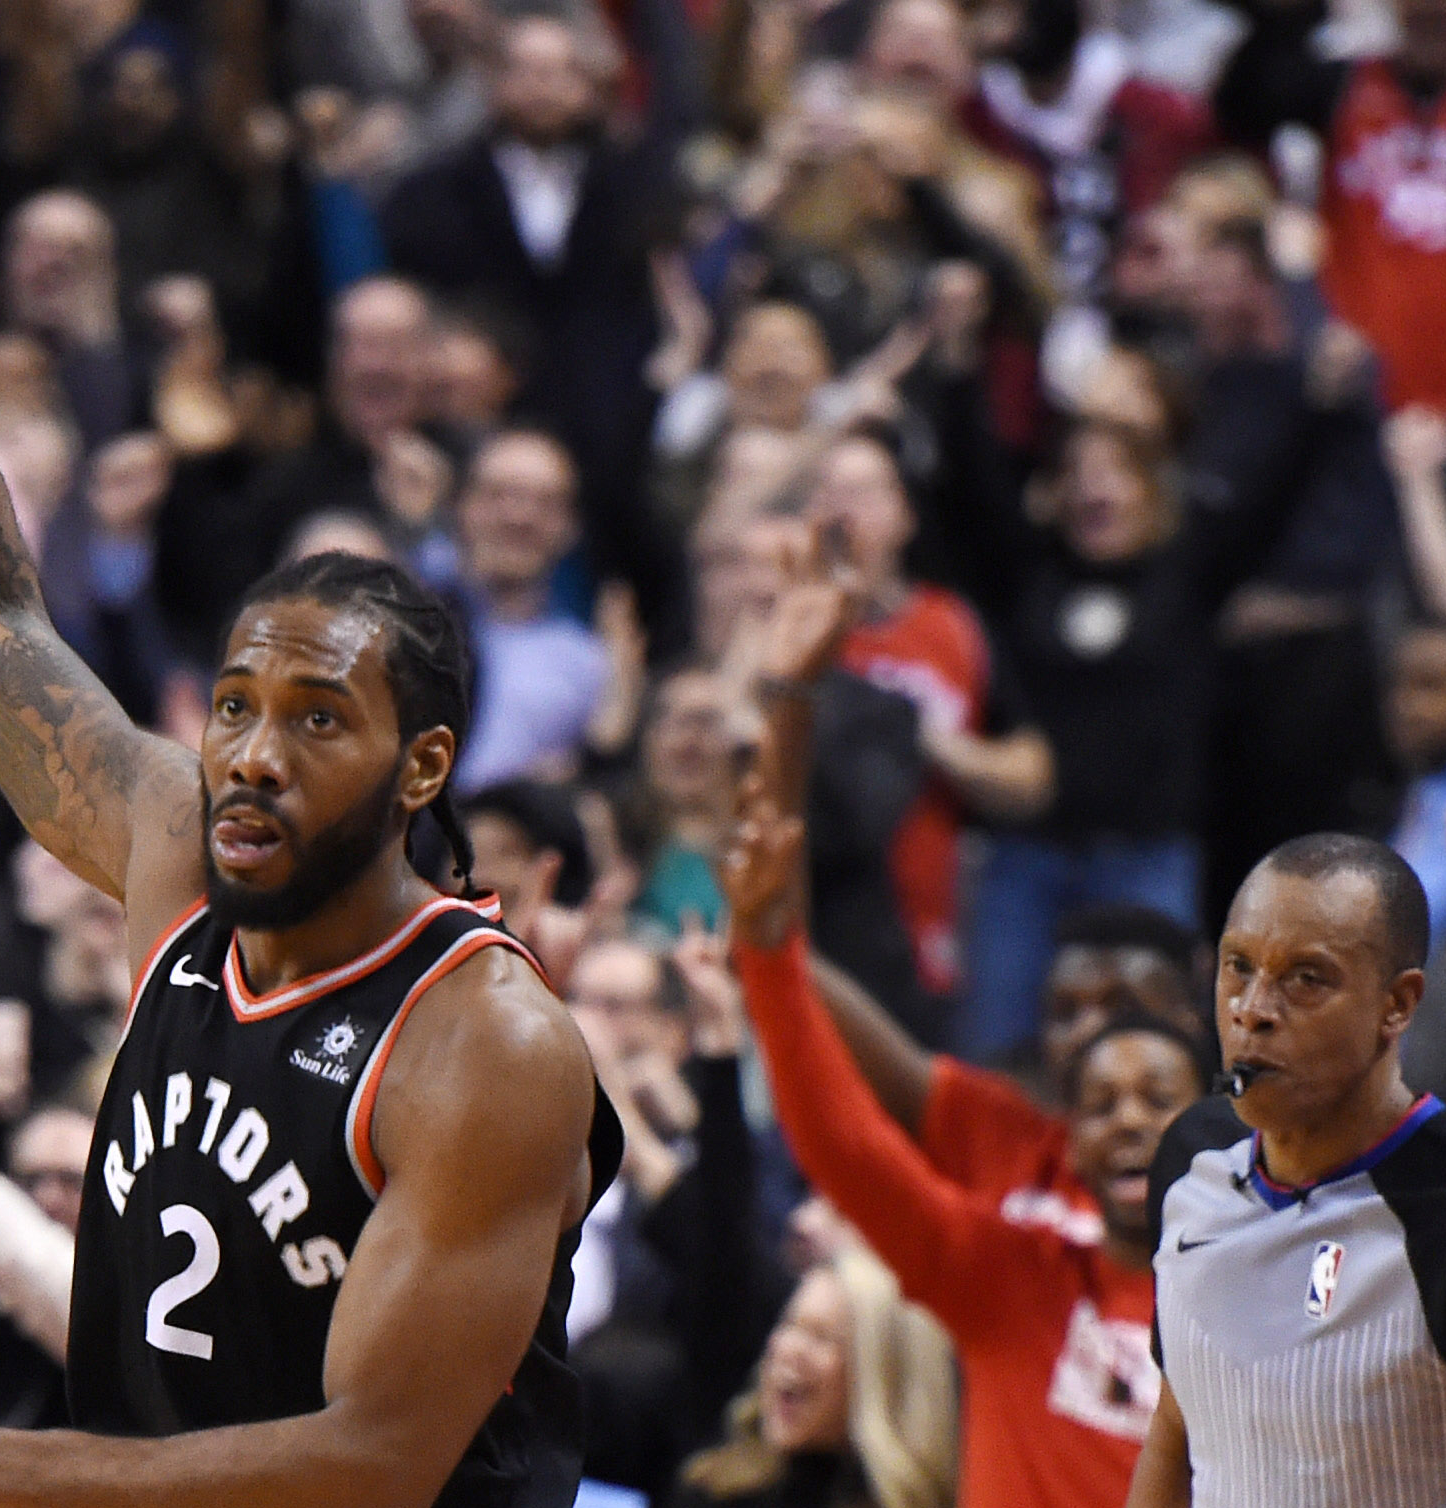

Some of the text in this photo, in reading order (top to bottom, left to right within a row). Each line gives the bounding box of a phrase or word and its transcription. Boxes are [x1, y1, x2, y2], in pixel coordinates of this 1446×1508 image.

[289, 1048, 351, 1085] Sun Life
[102, 1070, 351, 1288] RAPTORS
[145, 1203, 221, 1361] 2
